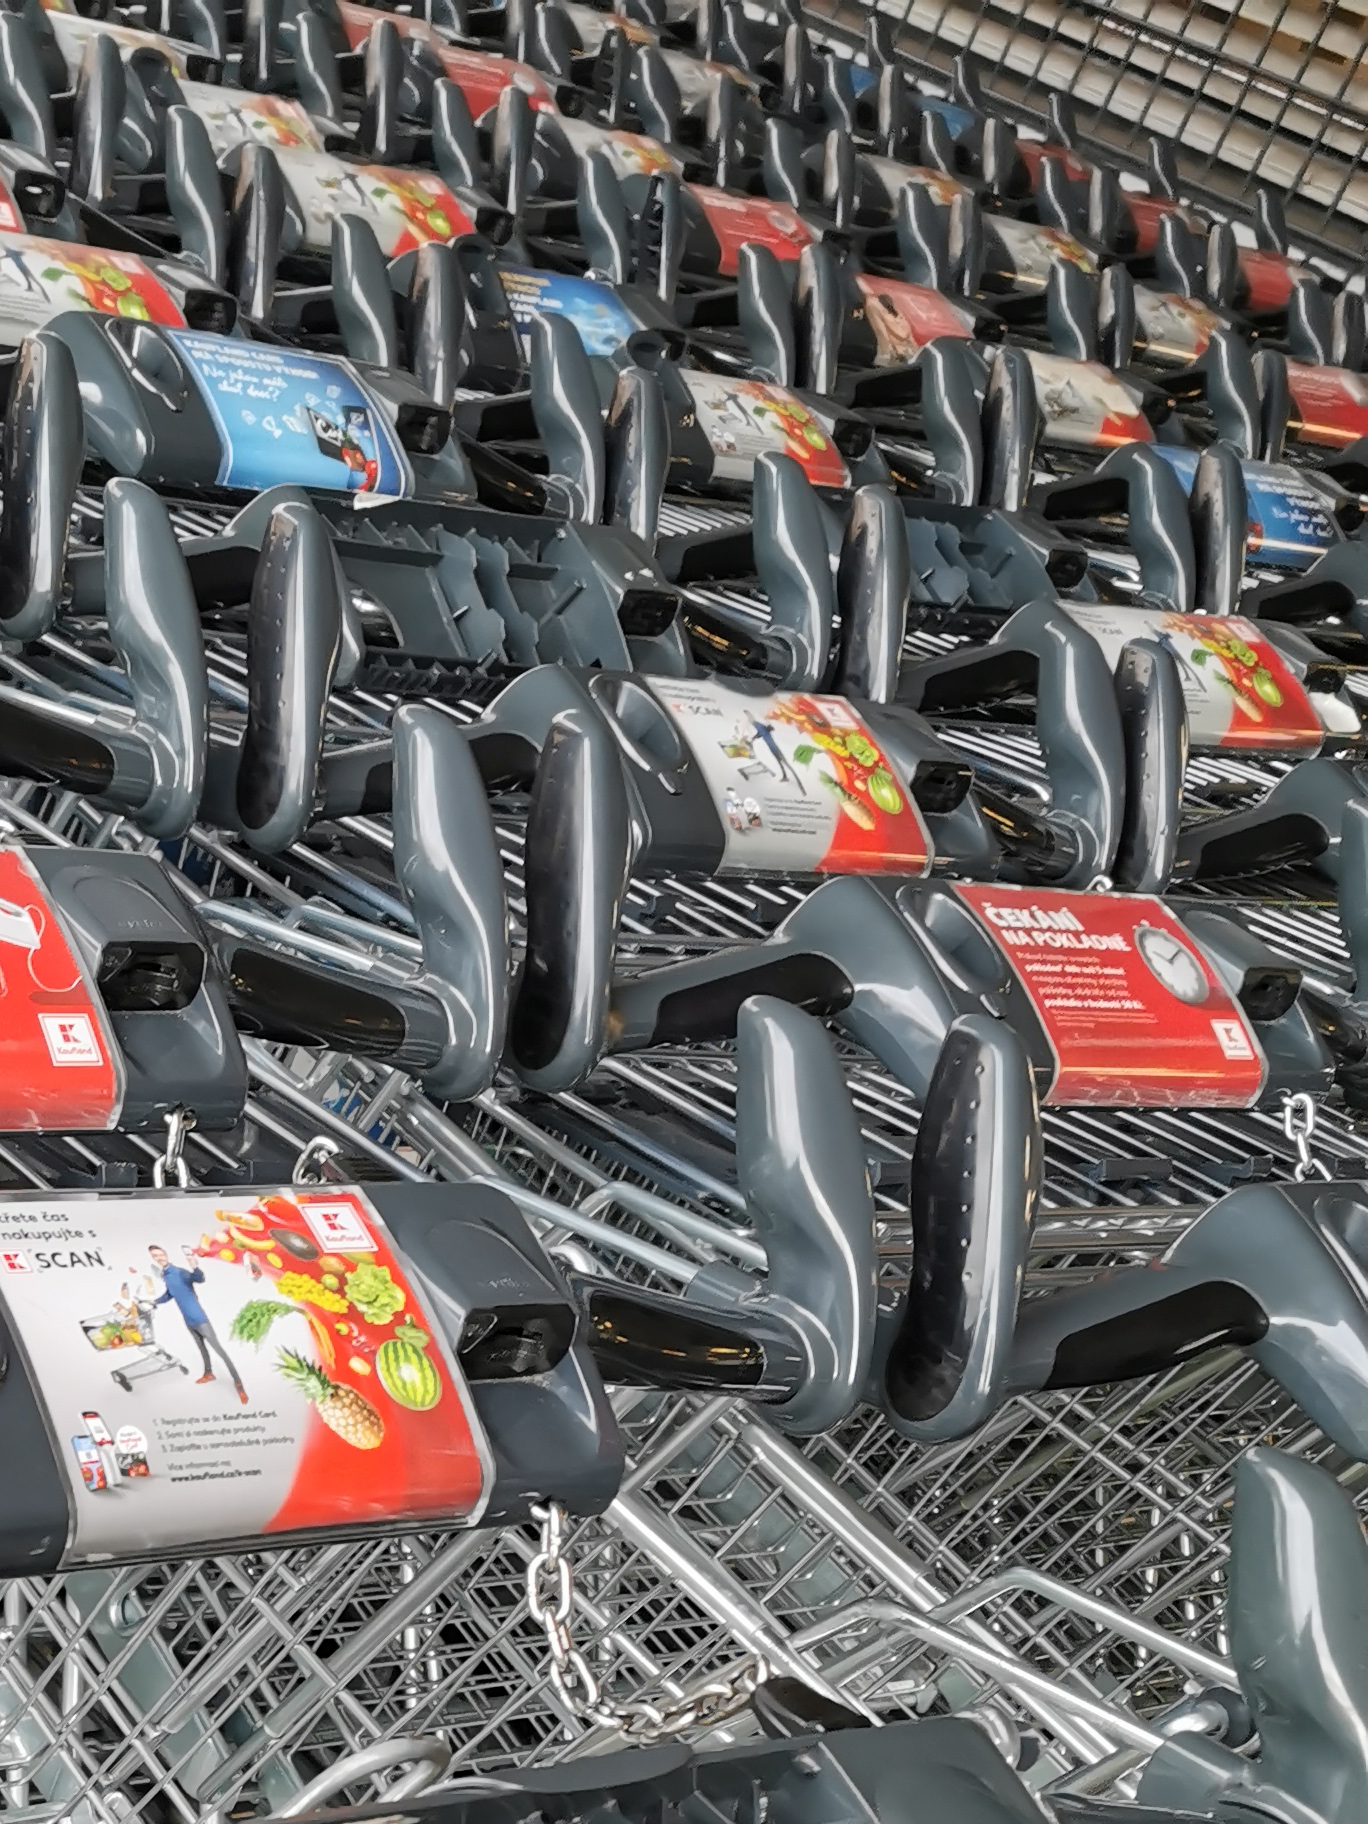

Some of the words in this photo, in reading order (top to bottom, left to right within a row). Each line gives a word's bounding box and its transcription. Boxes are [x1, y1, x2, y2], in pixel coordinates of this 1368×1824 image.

[982, 901, 1085, 932] ČEKÁNÍ
[1000, 930, 1032, 946] NA
[1031, 931, 1132, 952] POKLADNĚ
[41, 1211, 69, 1223] čas
[1, 1228, 84, 1243] nakupujte
[35, 1250, 107, 1269] SCAN
